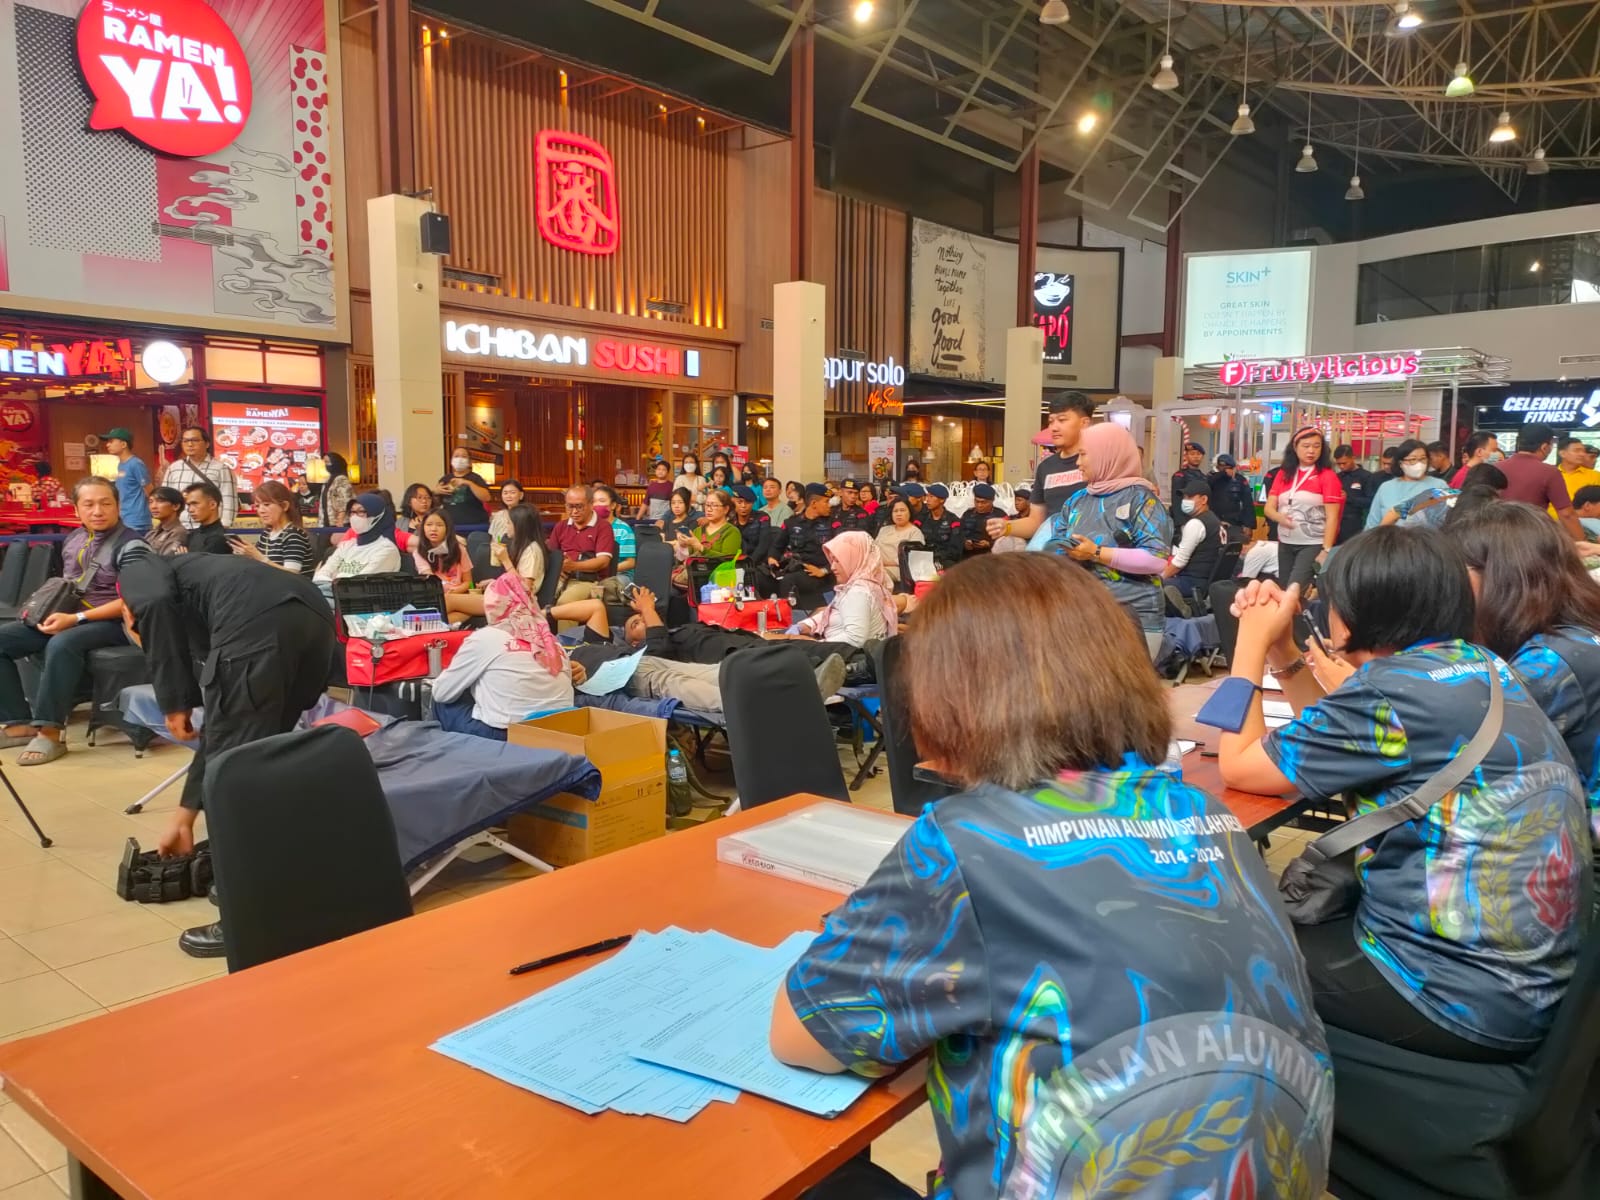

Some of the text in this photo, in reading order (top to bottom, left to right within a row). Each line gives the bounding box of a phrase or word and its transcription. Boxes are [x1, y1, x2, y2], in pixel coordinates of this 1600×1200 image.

[103, 15, 225, 67] RAMEN
[99, 54, 243, 124] YA!
[1219, 300, 1270, 309] GREAT SKIN
[931, 305, 961, 335] good
[1203, 327, 1284, 338] BY APPOINTMENTS
[51, 338, 135, 376] YA!
[446, 320, 681, 376] ICHIBAN SUSHI
[931, 328, 966, 367] food
[866, 356, 905, 386] solo
[1246, 354, 1420, 384] Fruitylicious
[1503, 397, 1584, 412] CELEBRITY
[1523, 411, 1577, 423] FITNESS
[1023, 818, 1123, 848] HIMPUNAN
[1123, 818, 1180, 840] ALUMNI
[1150, 849, 1188, 864] 2014
[1197, 846, 1225, 862] 2024
